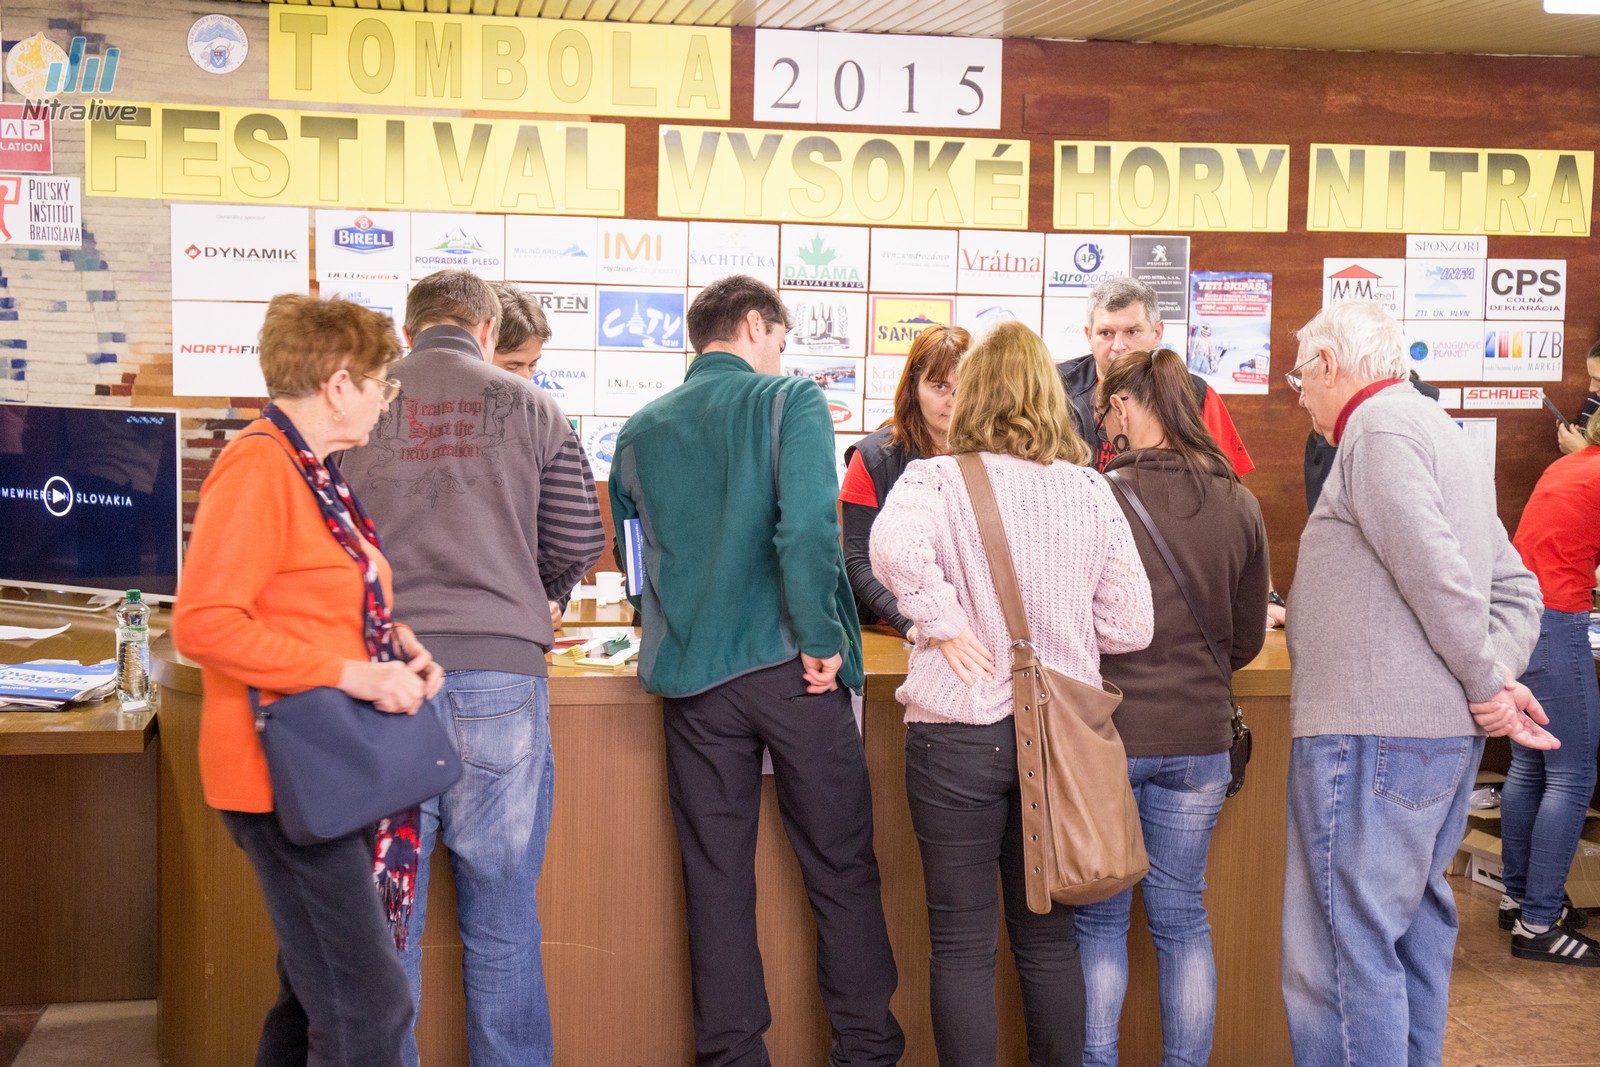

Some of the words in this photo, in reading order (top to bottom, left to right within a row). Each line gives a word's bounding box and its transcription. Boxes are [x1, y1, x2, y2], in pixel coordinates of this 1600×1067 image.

[279, 13, 720, 109] TOMBOLA
[770, 57, 985, 116] 2015
[91, 105, 620, 211] FESTIVAL
[663, 129, 1024, 226] VYSOKÉ
[1059, 145, 1287, 229] HORY
[1313, 147, 1587, 234] NITRA
[30, 224, 80, 242] BRATISLAVA
[339, 230, 390, 246] BIRELL
[604, 231, 662, 262] IMI
[1415, 240, 1480, 252] SPONZORI
[204, 247, 297, 260] DYNAMIK
[690, 250, 776, 268] ŠACHTIČKA
[414, 255, 468, 265] POPRADSKÉ
[472, 257, 500, 266] PLESO
[961, 248, 1041, 273] Vrátna
[603, 264, 638, 273] Hydronic
[784, 265, 860, 281] DAJAMA
[1440, 267, 1475, 280] INFA
[1051, 271, 1124, 285] Agropod
[1491, 269, 1561, 297] CPS
[1223, 282, 1268, 291] SKIPASS
[1506, 296, 1544, 304] COLNÁ
[1450, 310, 1470, 318] PLYN
[1490, 304, 1561, 312] DEKLARÁCIA
[1527, 331, 1562, 359] TZB
[1527, 362, 1561, 371] MARKET
[550, 370, 586, 379] ORAVA
[638, 381, 665, 389] s.r.o.
[1466, 389, 1540, 399] SCHAUER
[0, 487, 52, 501] MEWHERE
[76, 492, 133, 507] SLOVAKIA
